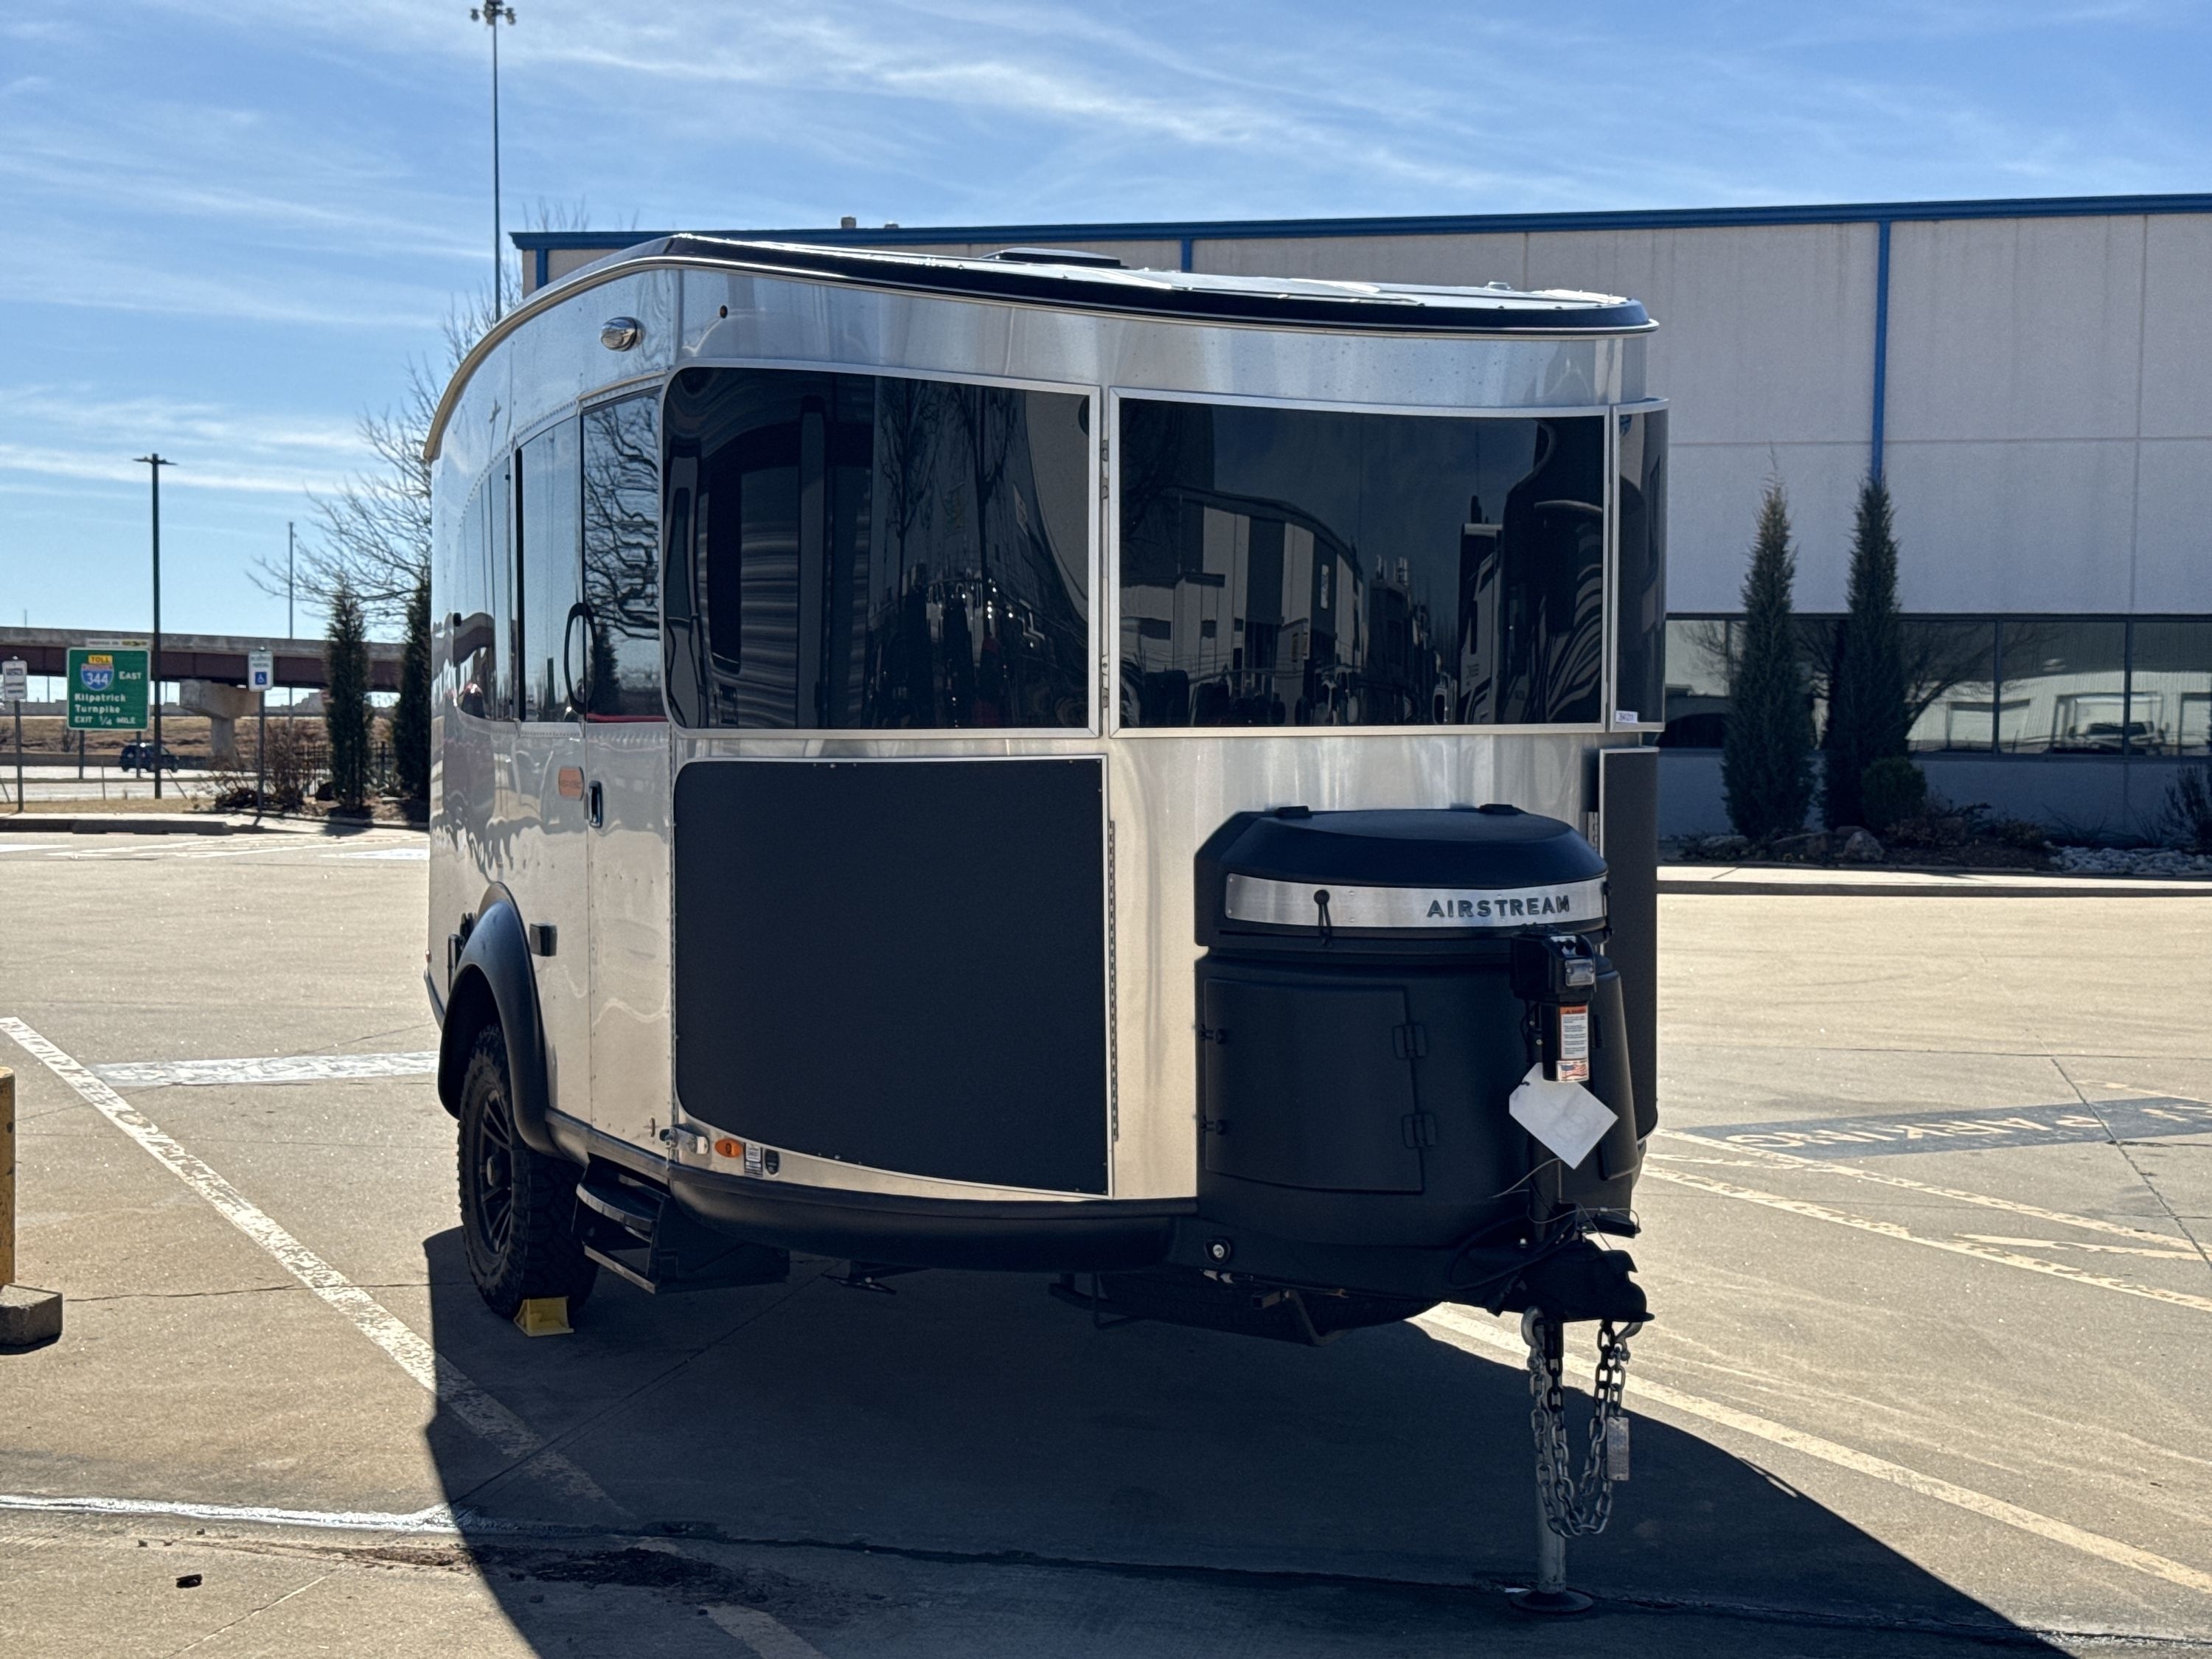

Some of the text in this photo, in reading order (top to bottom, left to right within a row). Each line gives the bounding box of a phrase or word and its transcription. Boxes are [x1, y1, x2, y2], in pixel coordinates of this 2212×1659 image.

[86, 672, 108, 685] 344
[119, 671, 142, 680] EAST
[74, 693, 126, 703] Kilpatrick
[74, 704, 120, 714] Turnpike
[1427, 894, 1570, 917] AIRSTREAM
[1725, 1115, 2104, 1148] PARKING
